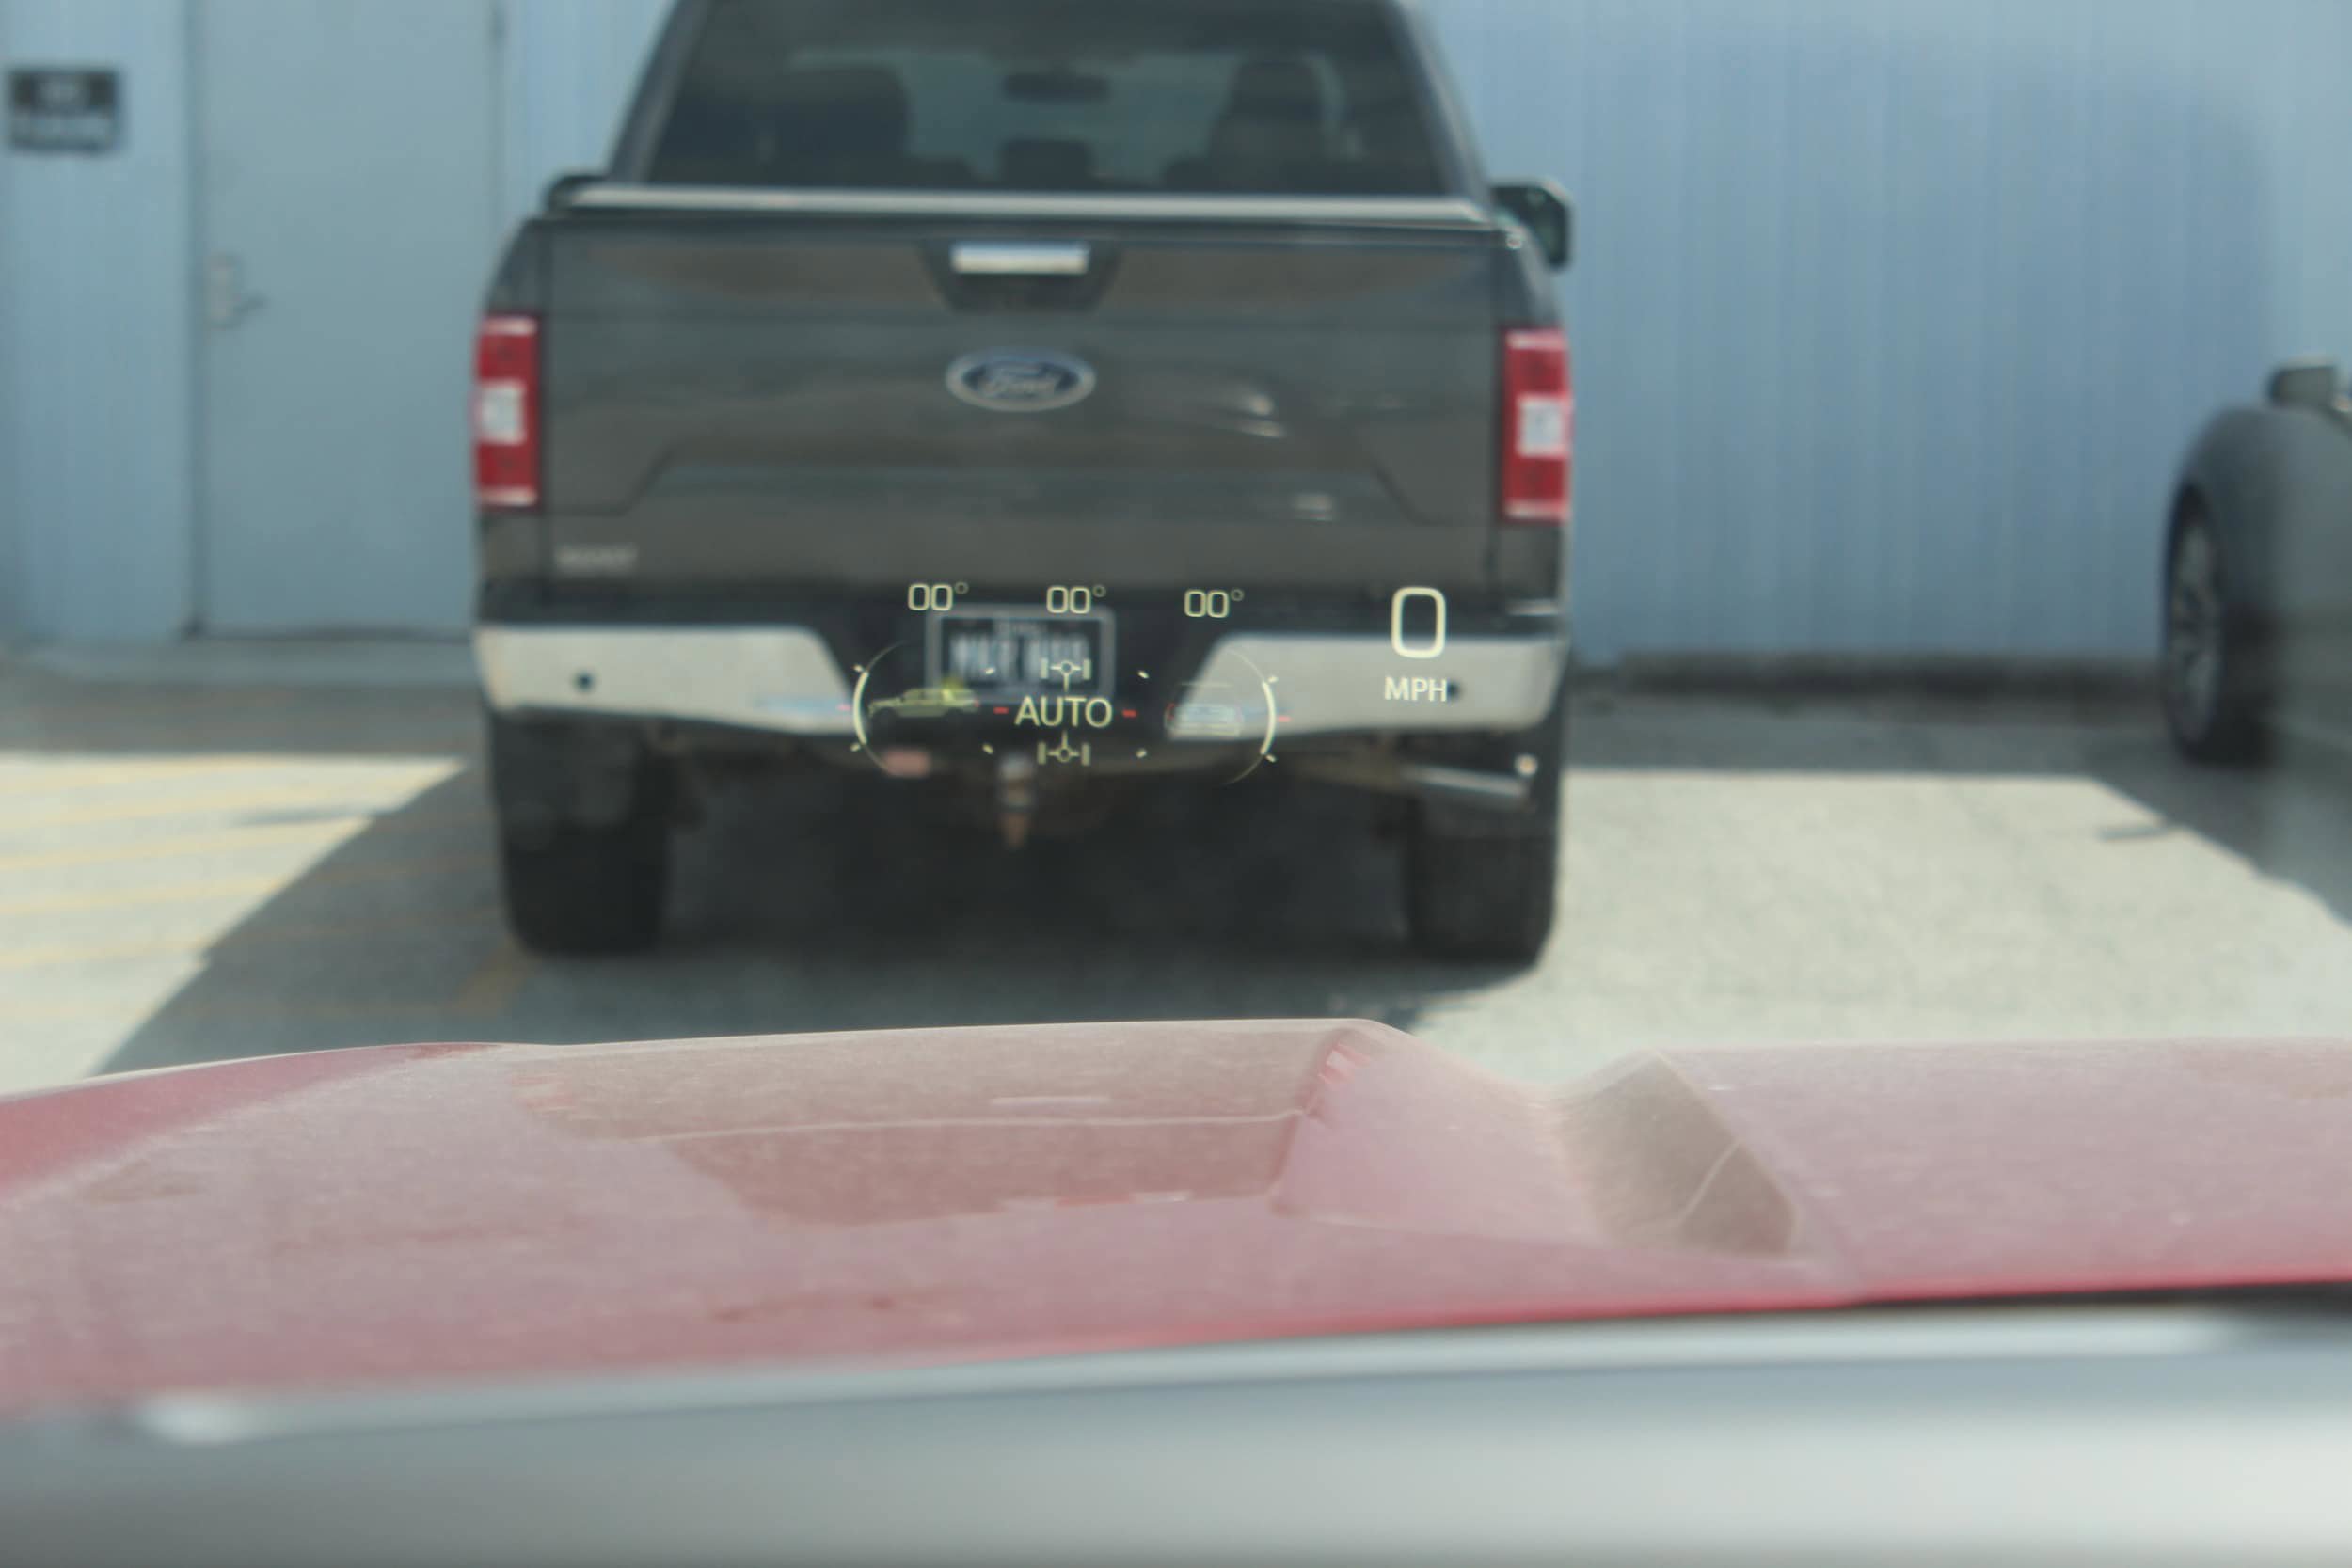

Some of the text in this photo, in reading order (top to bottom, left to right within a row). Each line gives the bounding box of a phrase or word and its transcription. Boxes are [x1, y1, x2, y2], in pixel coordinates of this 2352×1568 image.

[1391, 586, 1446, 659] 0
[1384, 676, 1448, 702] MPH
[1013, 695, 1113, 728] AUTO
